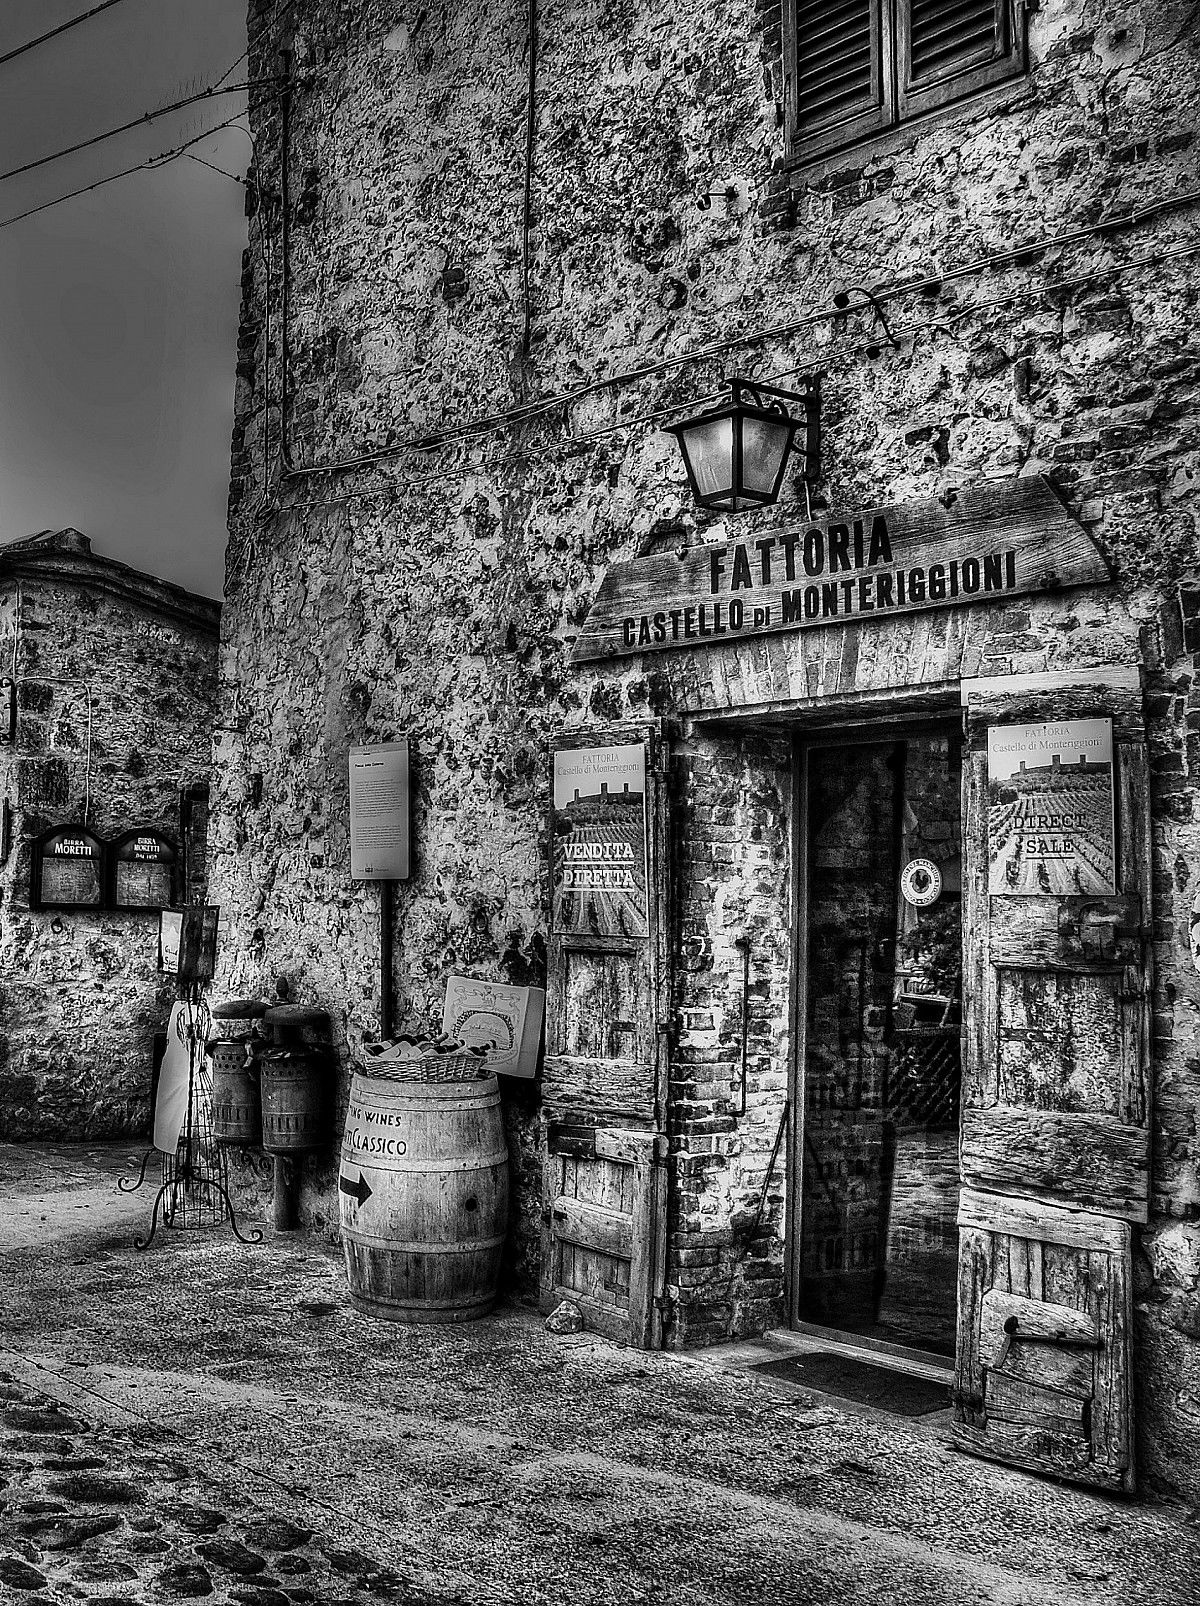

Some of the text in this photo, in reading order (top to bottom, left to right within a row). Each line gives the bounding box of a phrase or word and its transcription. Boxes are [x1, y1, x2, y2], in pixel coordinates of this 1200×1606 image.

[710, 515, 893, 594] FATTORIA
[622, 598, 744, 648] CASTELLO
[781, 551, 1016, 624] MONTERIGGIONI
[1025, 727, 1070, 738] FATTORIA
[993, 736, 1103, 753] Castello di Monteriggioni
[582, 753, 620, 764] FATTORIA
[557, 763, 640, 776] Castello di Monteriggioni
[1013, 814, 1087, 829] DIRECT
[54, 843, 92, 856] MORETTI
[63, 838, 85, 846] BIRRA
[133, 844, 160, 853] MORETTI
[1026, 839, 1074, 854] SALE
[562, 842, 635, 859] VENDITA
[563, 869, 635, 886] DIRETTA
[364, 1110, 402, 1127] WINES
